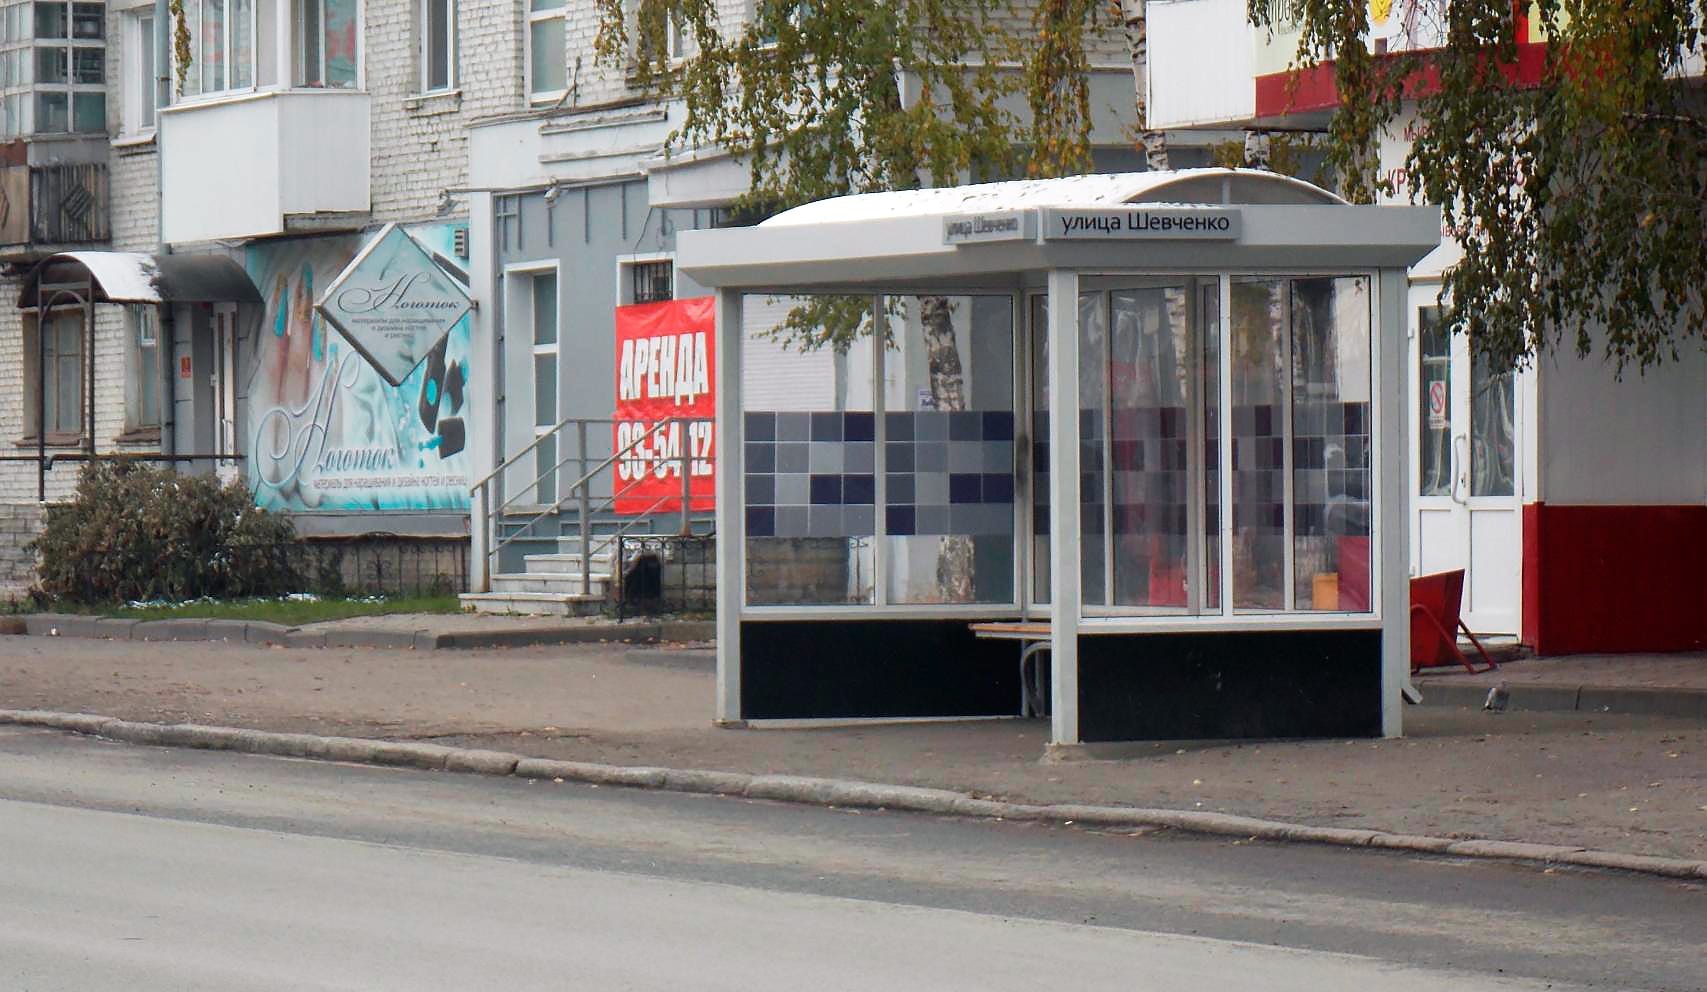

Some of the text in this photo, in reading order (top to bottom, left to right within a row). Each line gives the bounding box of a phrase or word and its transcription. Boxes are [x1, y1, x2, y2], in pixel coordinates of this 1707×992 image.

[946, 218, 972, 240] улица
[1062, 212, 1230, 234] улица Шевченко
[620, 331, 709, 406] АРЕНДА
